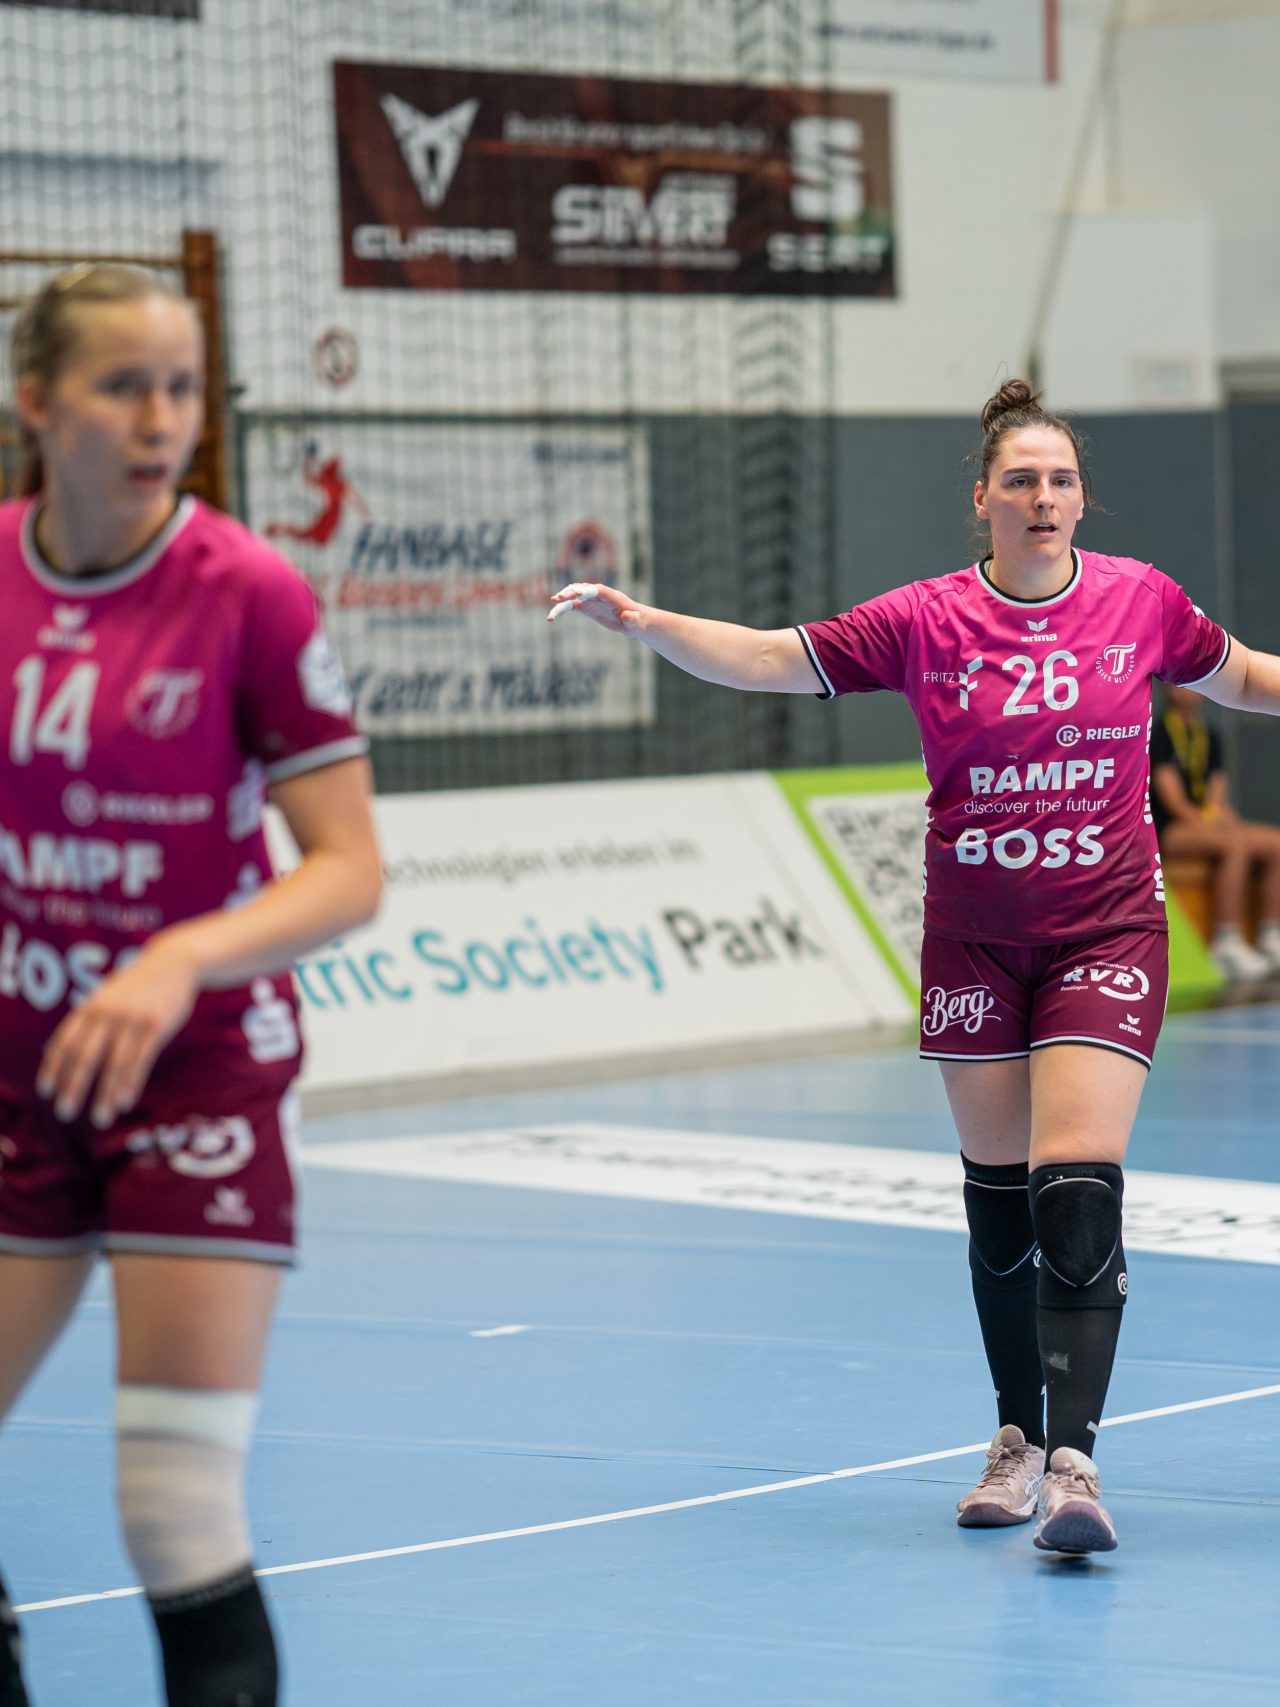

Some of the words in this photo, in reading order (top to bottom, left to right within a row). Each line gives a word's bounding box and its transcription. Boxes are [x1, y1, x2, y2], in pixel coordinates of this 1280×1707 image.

[1020, 633, 1057, 642] erima
[923, 671, 955, 683] FRITZ
[1001, 650, 1079, 716] 26
[9, 653, 101, 771] 14
[1086, 725, 1140, 741] RIEGLER
[969, 758, 1115, 796] RAMPF
[964, 800, 1030, 814] discover
[1035, 798, 1062, 813] the
[0, 826, 164, 899] AMPF
[955, 825, 1105, 869] BOSS
[413, 914, 666, 995] Society
[662, 896, 825, 971] Park
[1063, 968, 1134, 989] RVR
[922, 986, 1001, 1037] Berg
[1118, 1022, 1142, 1037] erima
